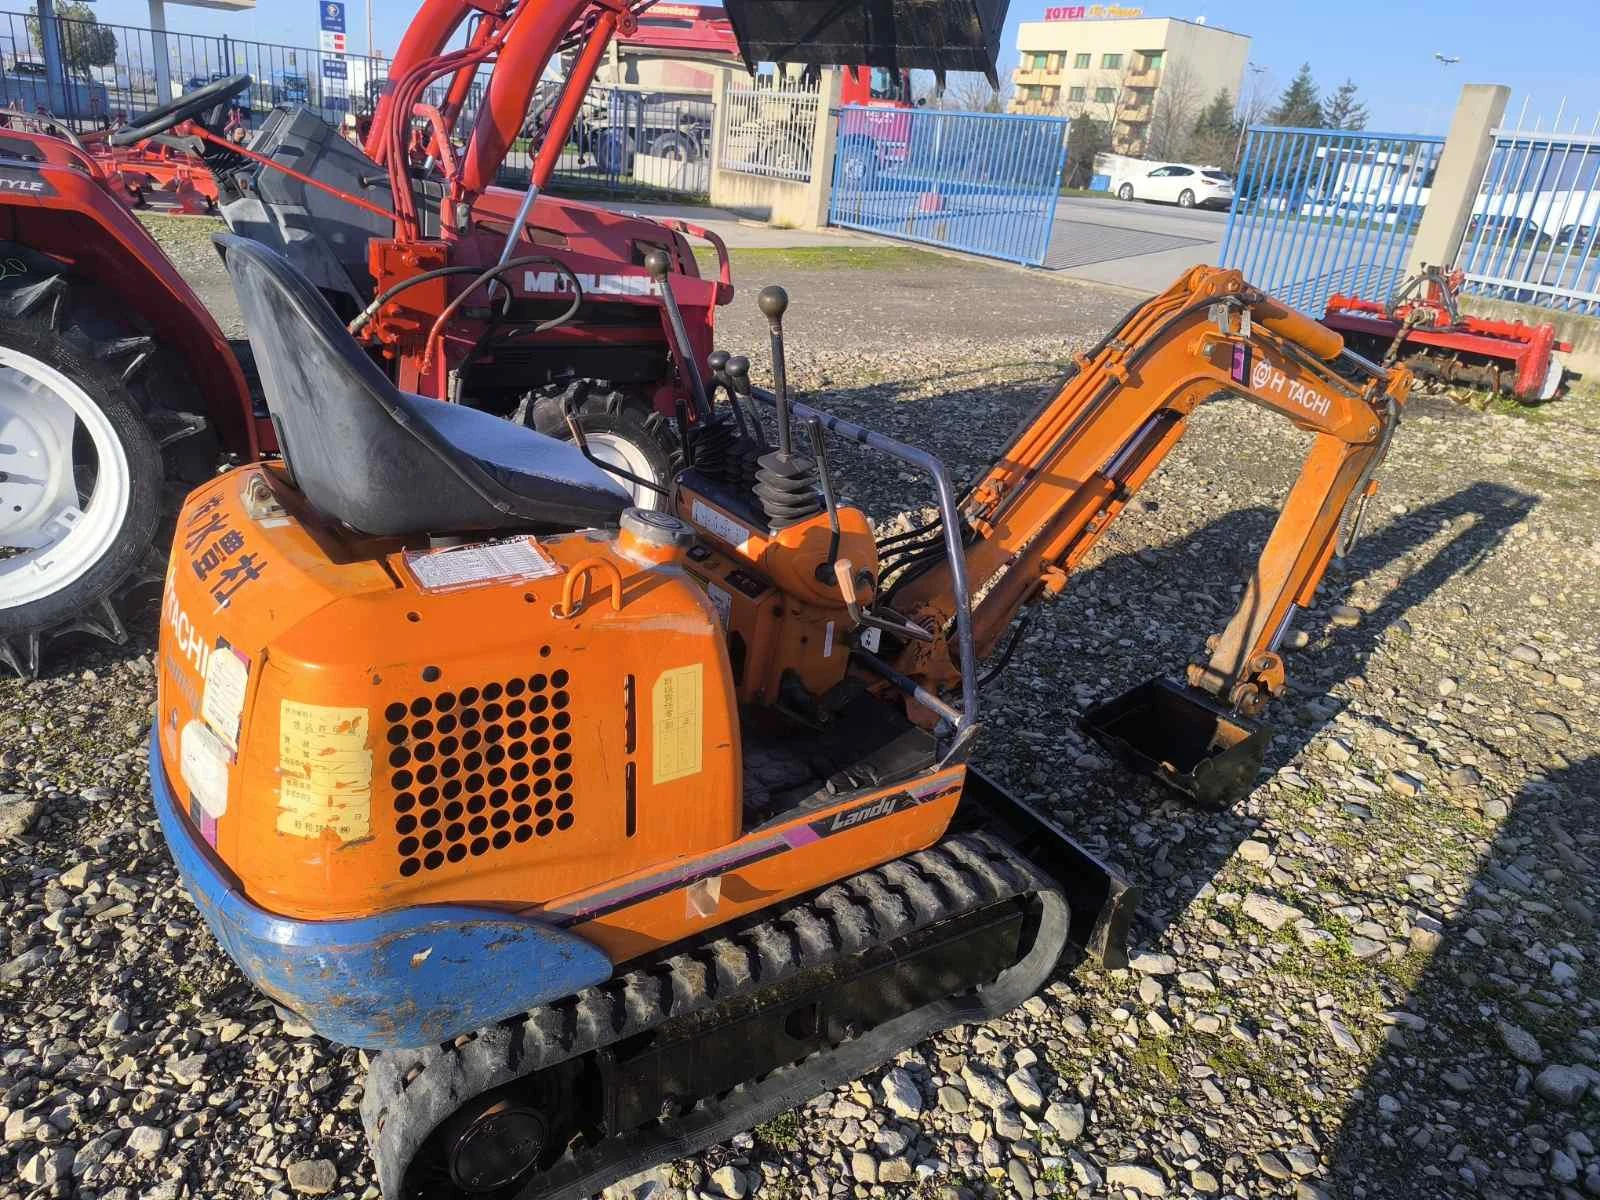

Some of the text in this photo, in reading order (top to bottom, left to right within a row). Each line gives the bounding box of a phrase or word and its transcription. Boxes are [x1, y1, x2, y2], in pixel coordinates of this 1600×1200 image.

[1045, 6, 1085, 20] ХОТЕЛ
[524, 270, 664, 297] MITSUBISH
[1270, 373, 1331, 416] HTACHI
[831, 798, 896, 831] Landy
